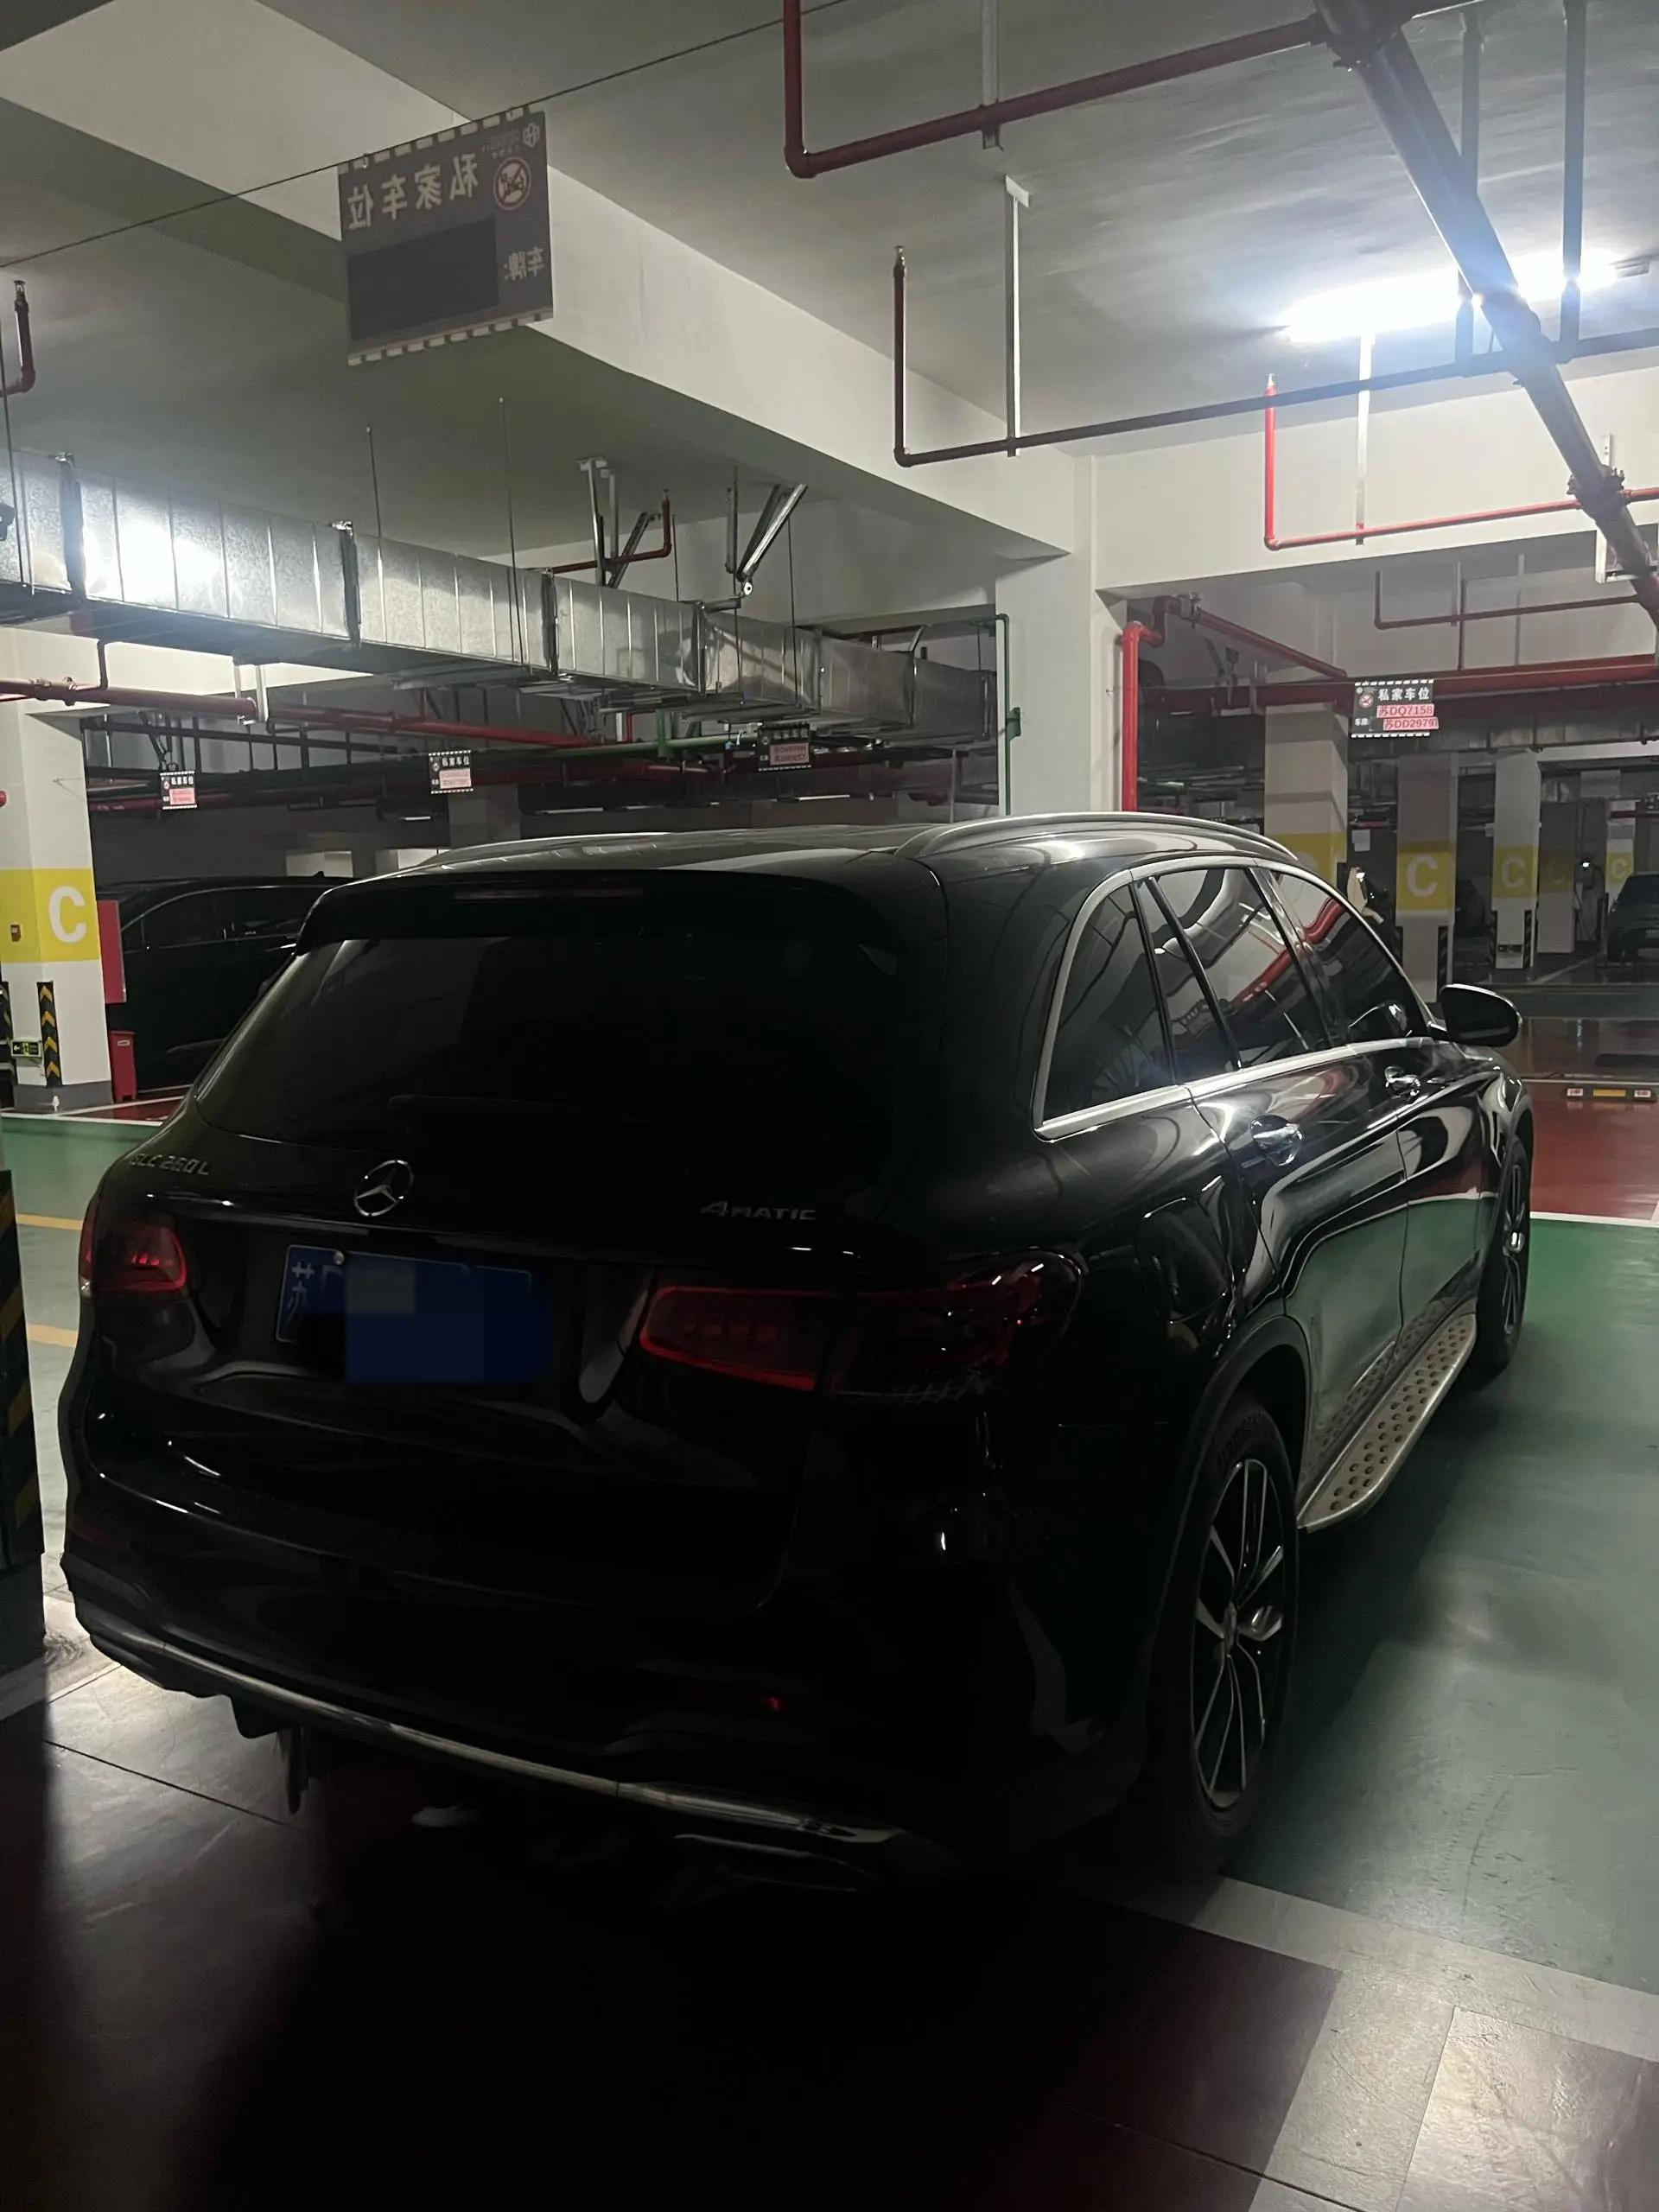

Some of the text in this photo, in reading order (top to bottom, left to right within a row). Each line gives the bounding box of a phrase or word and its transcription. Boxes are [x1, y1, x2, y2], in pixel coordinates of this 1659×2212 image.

[1378, 687, 1429, 701] 私家车位
[1406, 855, 1439, 897] C
[1502, 856, 1526, 888] C
[48, 886, 86, 944] C
[700, 1199, 817, 1220] 4MATIC
